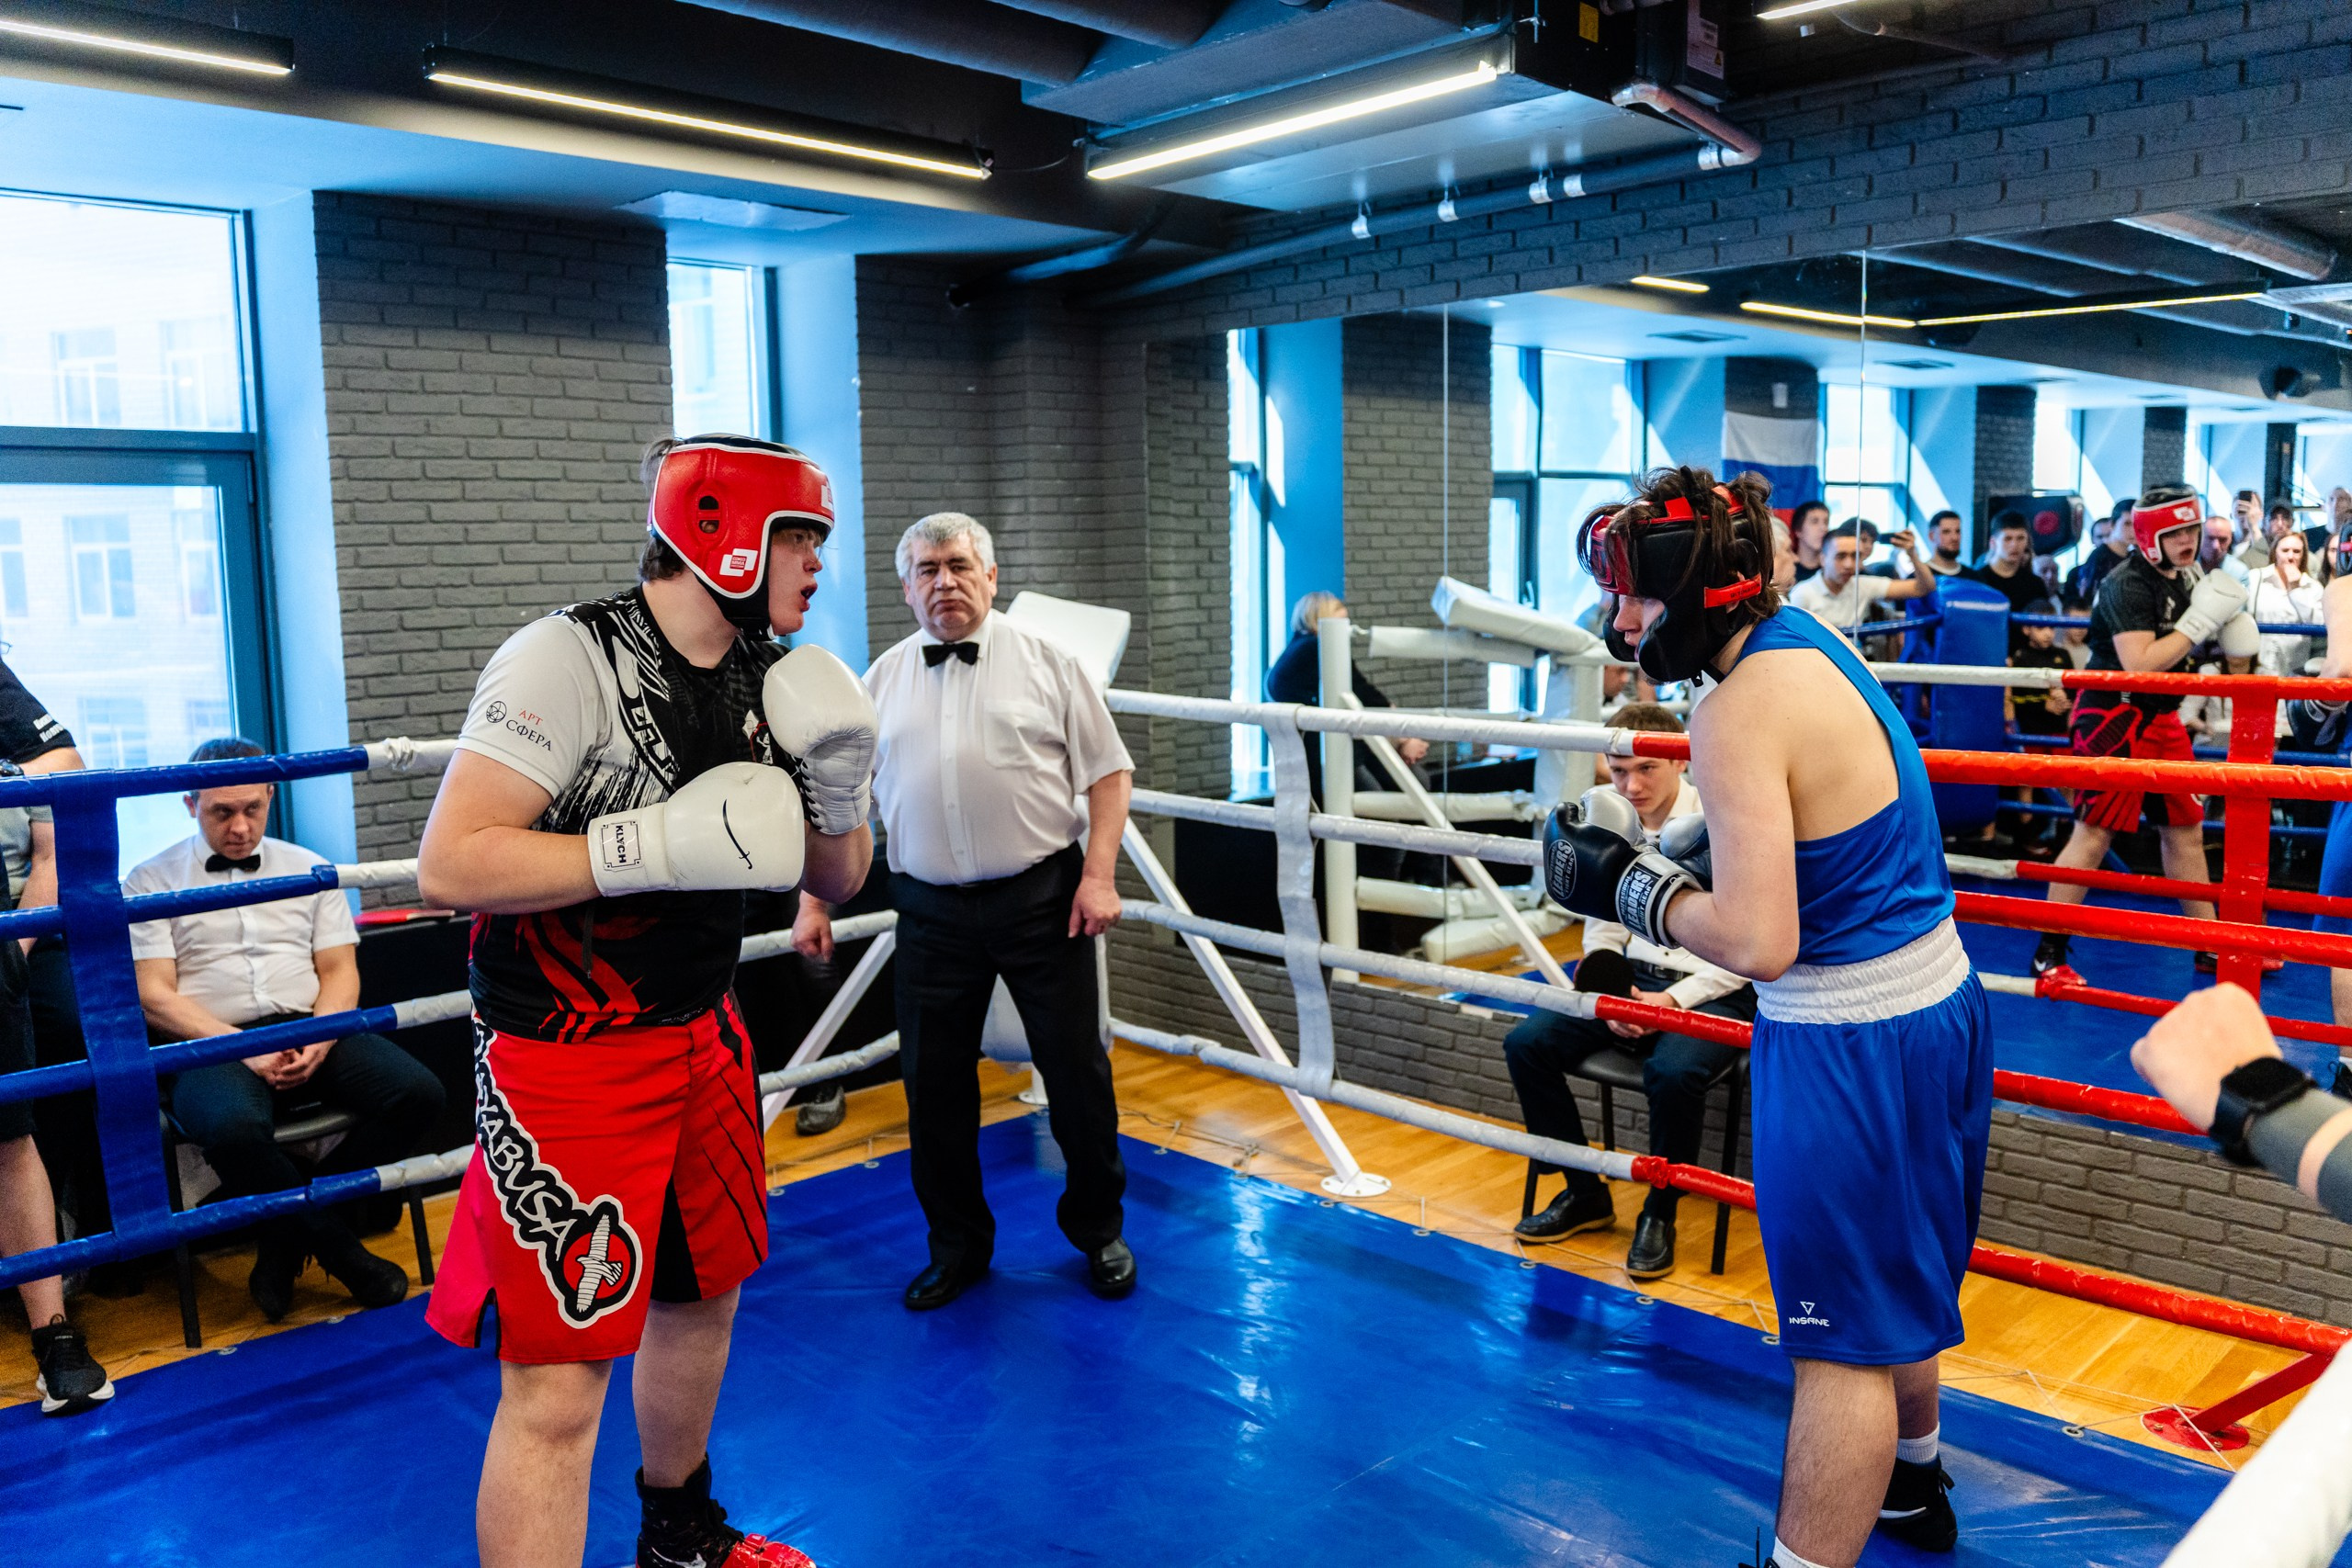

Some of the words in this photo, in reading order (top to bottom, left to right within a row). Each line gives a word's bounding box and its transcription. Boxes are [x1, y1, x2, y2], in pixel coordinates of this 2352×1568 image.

[506, 719, 551, 751] СФЕРА
[518, 709, 543, 726] АРТ
[616, 825, 627, 863] KLYCH
[1553, 841, 1572, 897] LEADERS
[1627, 871, 1651, 931] LEADERS
[1789, 1316, 1830, 1326] INSANE
